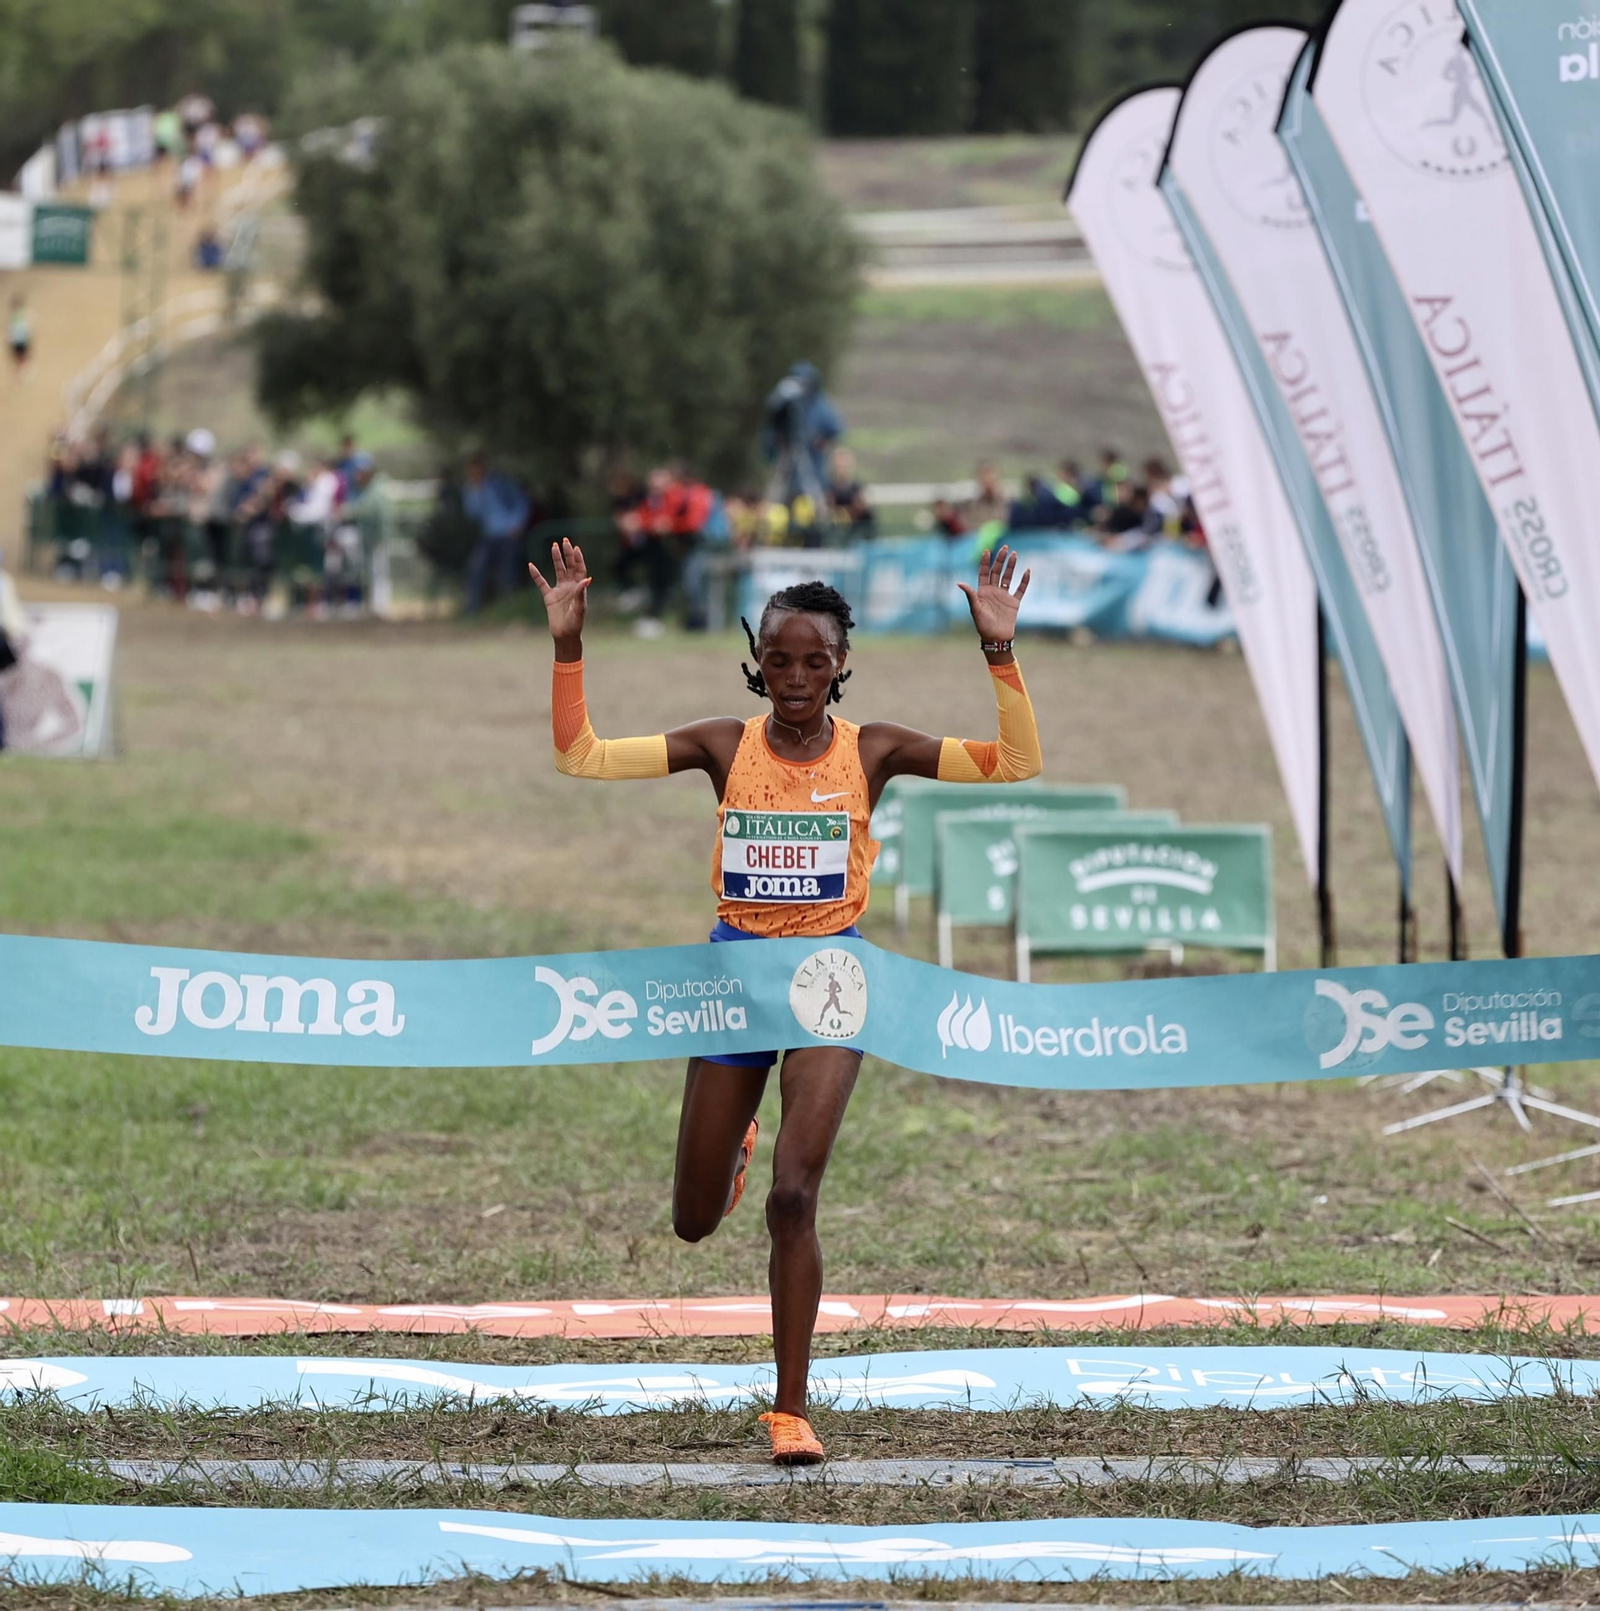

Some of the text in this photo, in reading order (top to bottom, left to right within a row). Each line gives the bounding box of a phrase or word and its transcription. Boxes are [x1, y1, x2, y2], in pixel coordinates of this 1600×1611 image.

[746, 817, 823, 837] ITÁLICA
[746, 844, 819, 869] CHEBET
[744, 876, 821, 898] Joma
[1070, 903, 1221, 932] SEVILLA
[796, 952, 864, 991] ITÁLICA
[135, 966, 405, 1037] Joma
[645, 975, 743, 1002] Diputación
[1443, 987, 1562, 1015] Diputación
[647, 1000, 748, 1036] Sevilla
[1444, 1011, 1562, 1047] Sevilla
[998, 1013, 1188, 1057] Iberdrola
